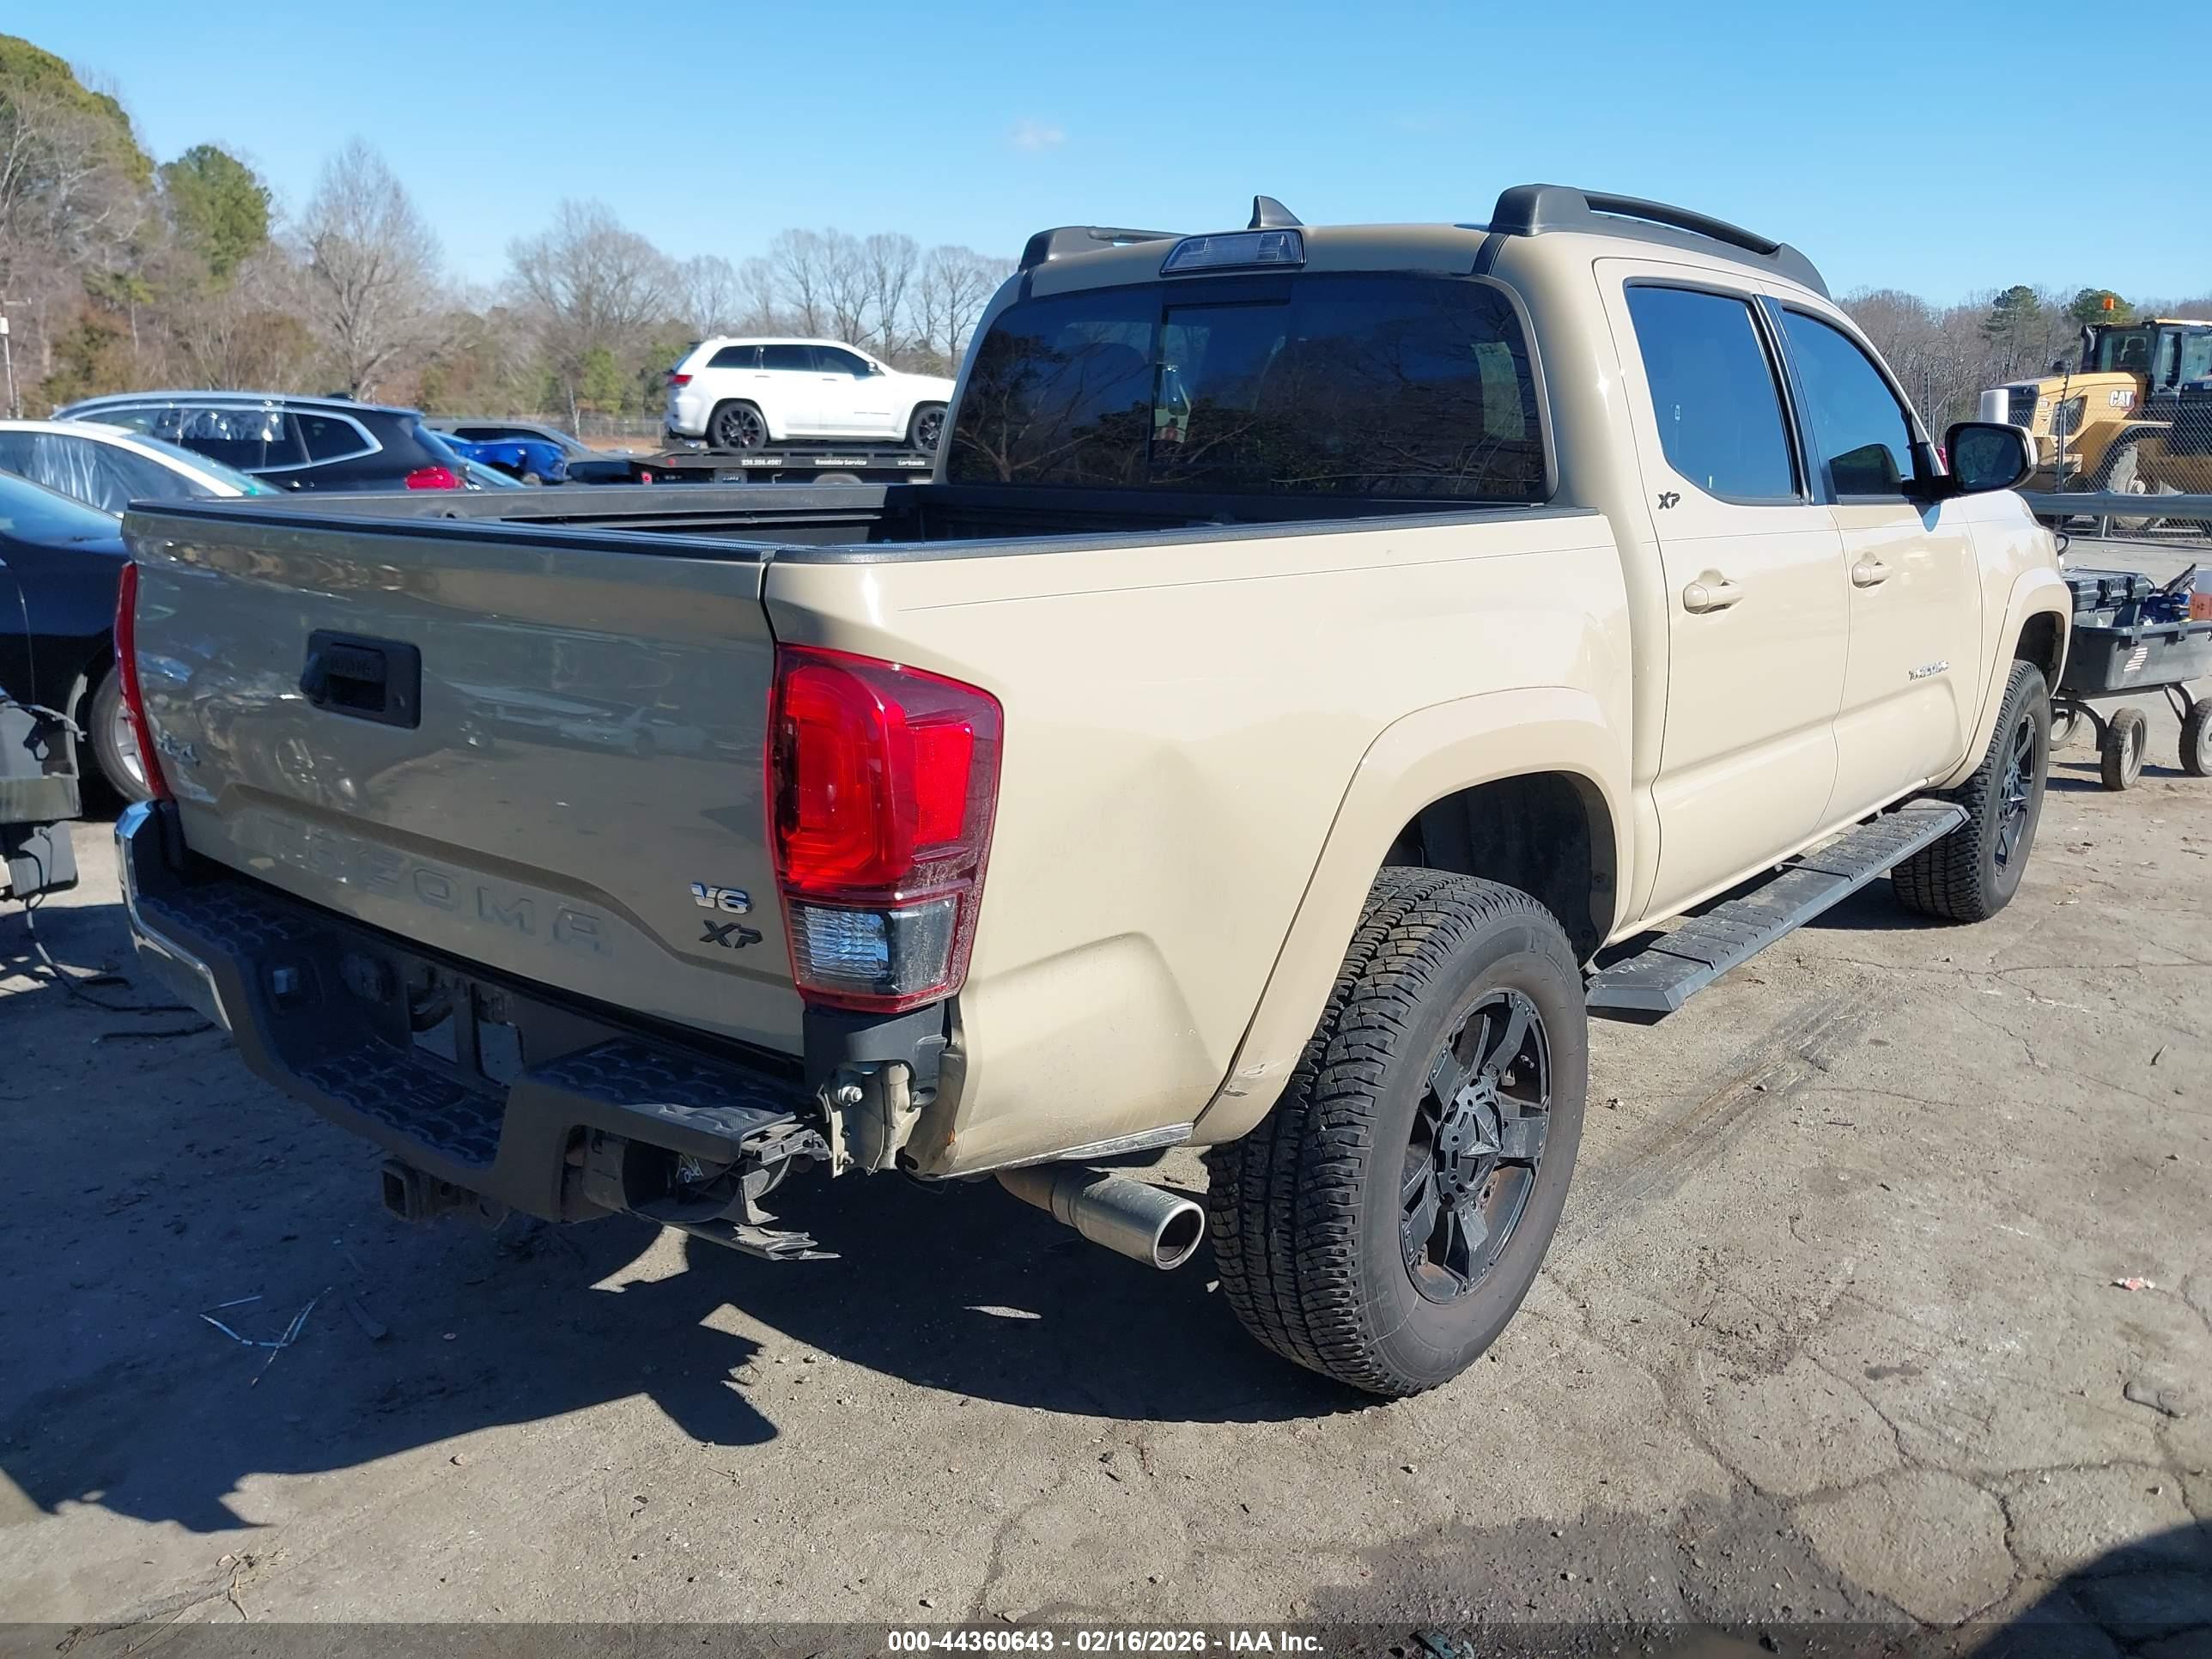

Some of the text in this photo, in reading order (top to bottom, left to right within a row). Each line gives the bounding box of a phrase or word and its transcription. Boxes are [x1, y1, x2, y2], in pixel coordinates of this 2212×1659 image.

[2109, 390, 2134, 407] CAT
[1657, 491, 1680, 510] XP
[690, 882, 753, 915] V6
[699, 920, 763, 949] XP
